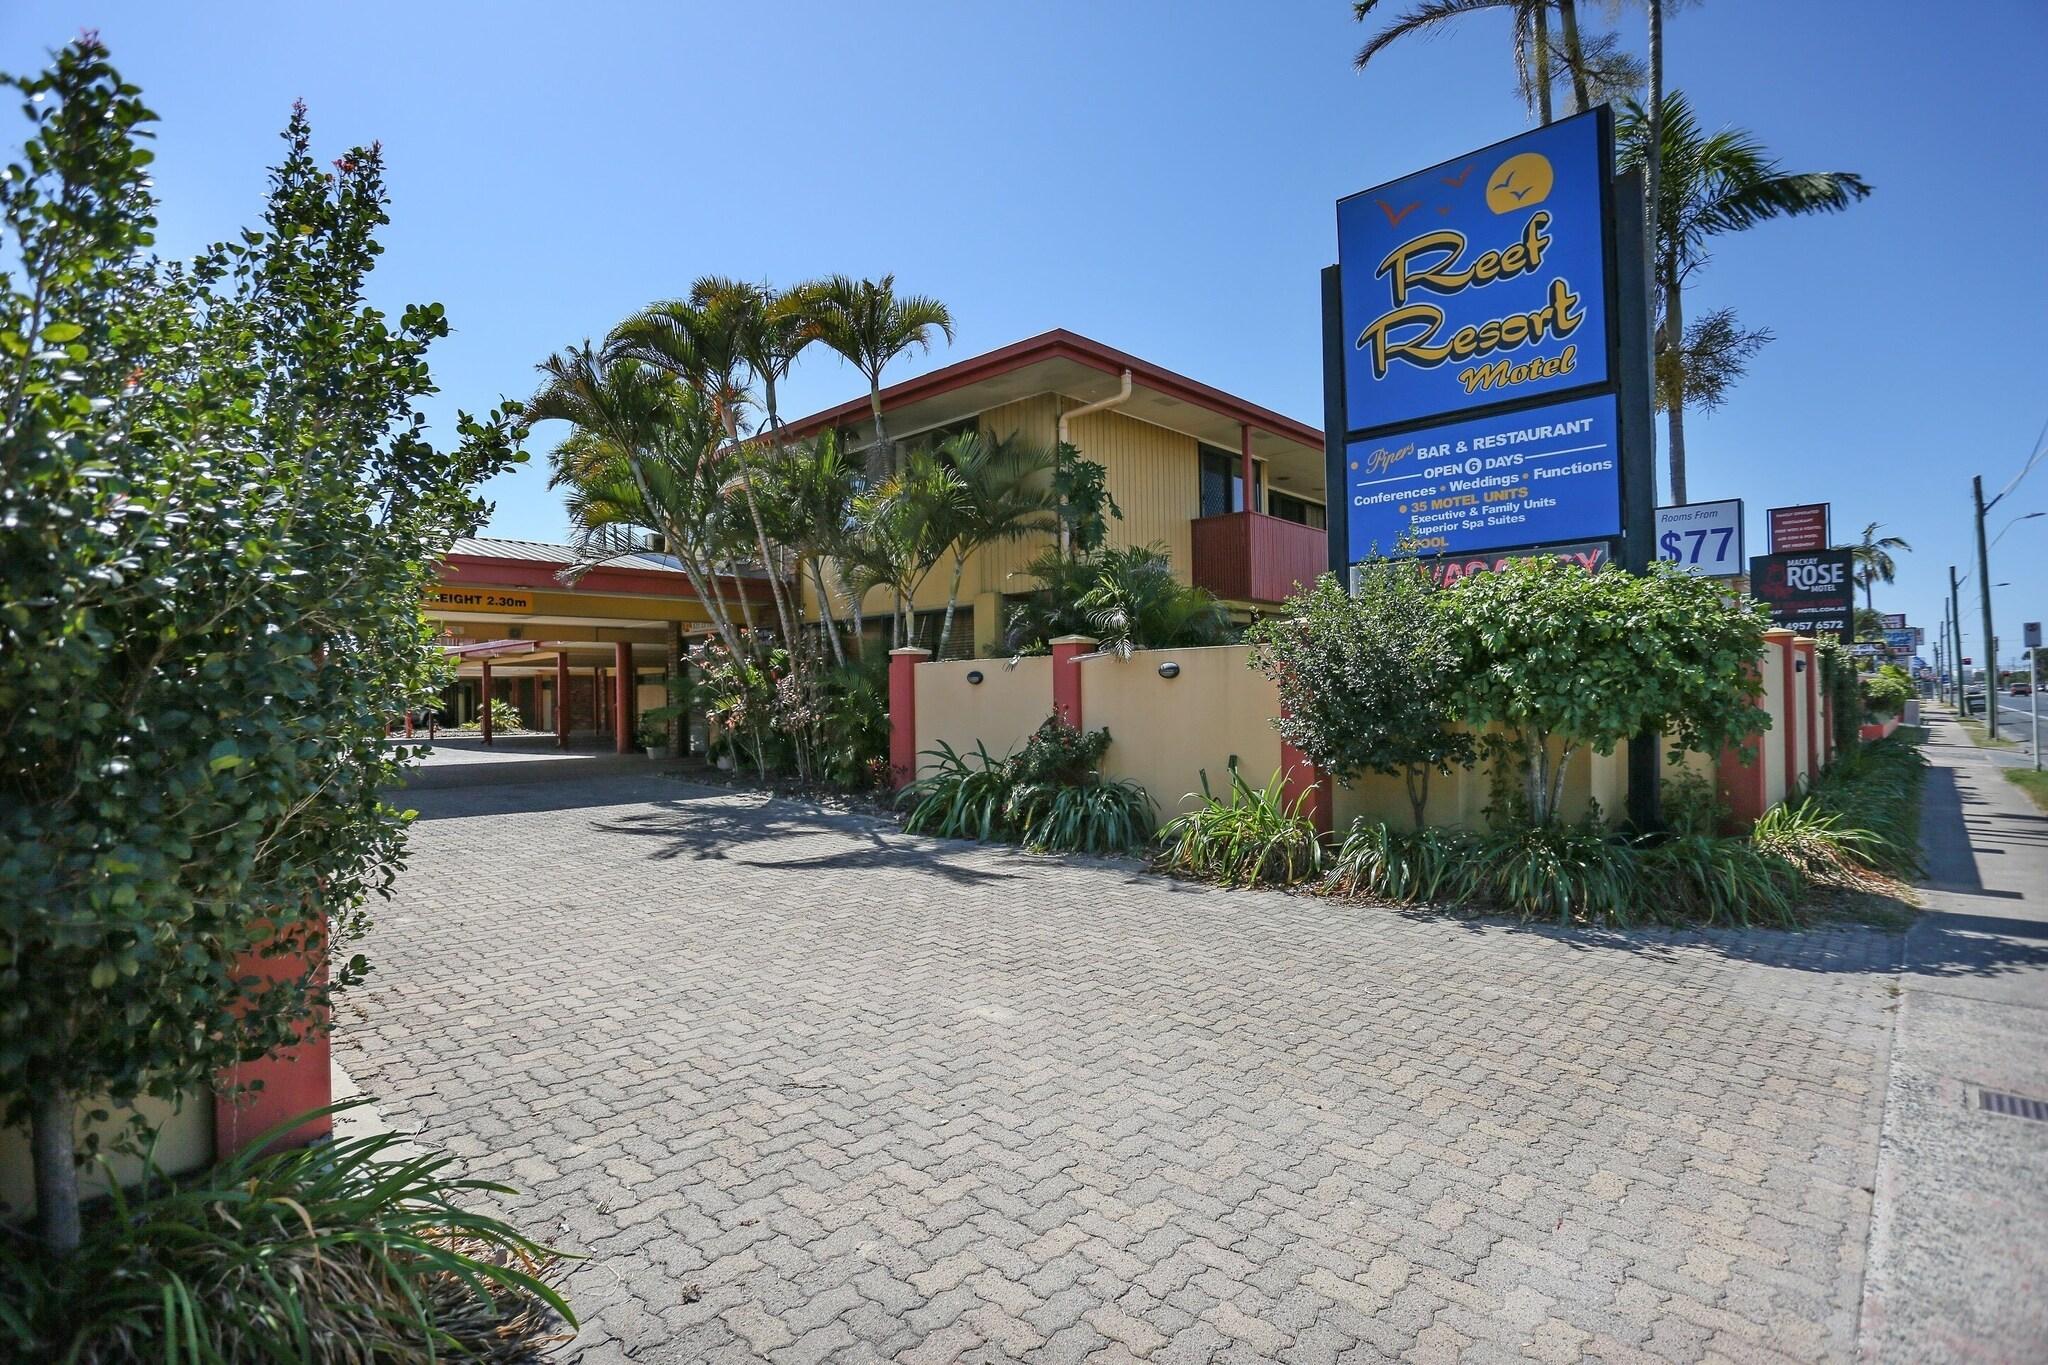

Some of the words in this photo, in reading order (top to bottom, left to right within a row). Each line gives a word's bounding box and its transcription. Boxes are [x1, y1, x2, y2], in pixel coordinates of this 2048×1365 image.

[1375, 211, 1551, 308] Reef
[1356, 277, 1587, 381] Resort
[1458, 346, 1577, 395] Motel
[1417, 443, 1451, 460] BAR
[1455, 440, 1468, 453] &
[1473, 417, 1594, 451] RESTAURANT
[1423, 463, 1463, 479] OPEN
[1485, 453, 1524, 470] DAYS
[1353, 486, 1437, 507] Conferences
[1449, 474, 1520, 492] Weddings
[1533, 460, 1614, 480] Functions
[1411, 501, 1429, 513] 35
[1431, 494, 1480, 510] MOTEL
[1483, 486, 1529, 502] UNITS
[1411, 510, 1466, 524] Executive
[1469, 506, 1479, 517] &
[1482, 502, 1521, 515] Family
[1523, 498, 1557, 510] Units
[1412, 523, 1459, 536] Superior
[1462, 520, 1485, 531] Spa
[1487, 514, 1527, 527] Suites
[1661, 512, 1693, 523] Rooms
[1694, 510, 1719, 520] From
[1659, 527, 1734, 567] $77
[1786, 557, 1818, 567] MACKAY
[1786, 563, 1844, 590] ROSE
[1810, 584, 1837, 593] MOTEL
[429, 592, 482, 606] EIGHT
[486, 596, 527, 607] 2.30m
[1815, 620, 1845, 630] 6572
